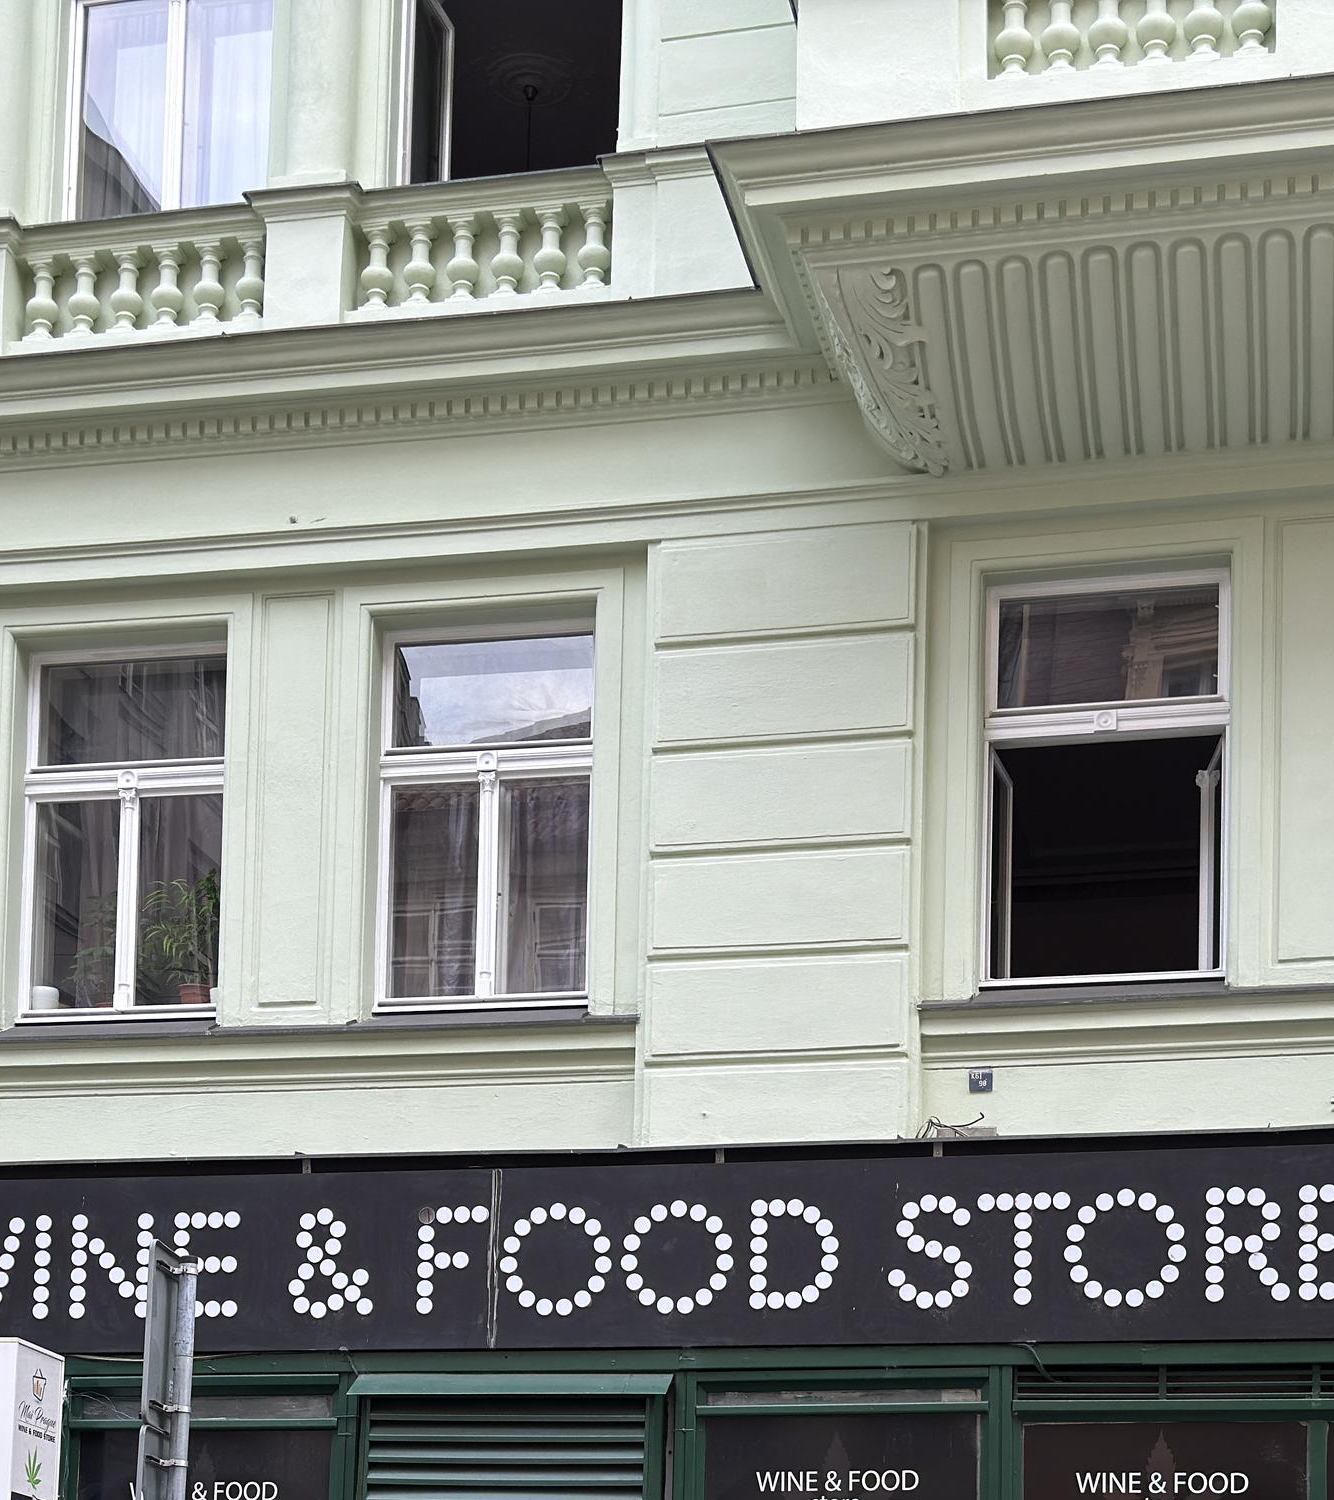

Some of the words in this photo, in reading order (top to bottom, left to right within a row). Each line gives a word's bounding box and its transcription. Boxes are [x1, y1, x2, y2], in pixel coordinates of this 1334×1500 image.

[287, 1207, 373, 1320] &
[416, 1199, 839, 1316] FOOD
[18, 1401, 33, 1423] Mai
[34, 1407, 56, 1436] Prague
[756, 1471, 818, 1492] WINE
[825, 1470, 842, 1491] &
[848, 1470, 919, 1491] FOOD
[1075, 1473, 1141, 1494] WINE
[1148, 1472, 1166, 1494] &
[1174, 1472, 1249, 1494] FOOD
